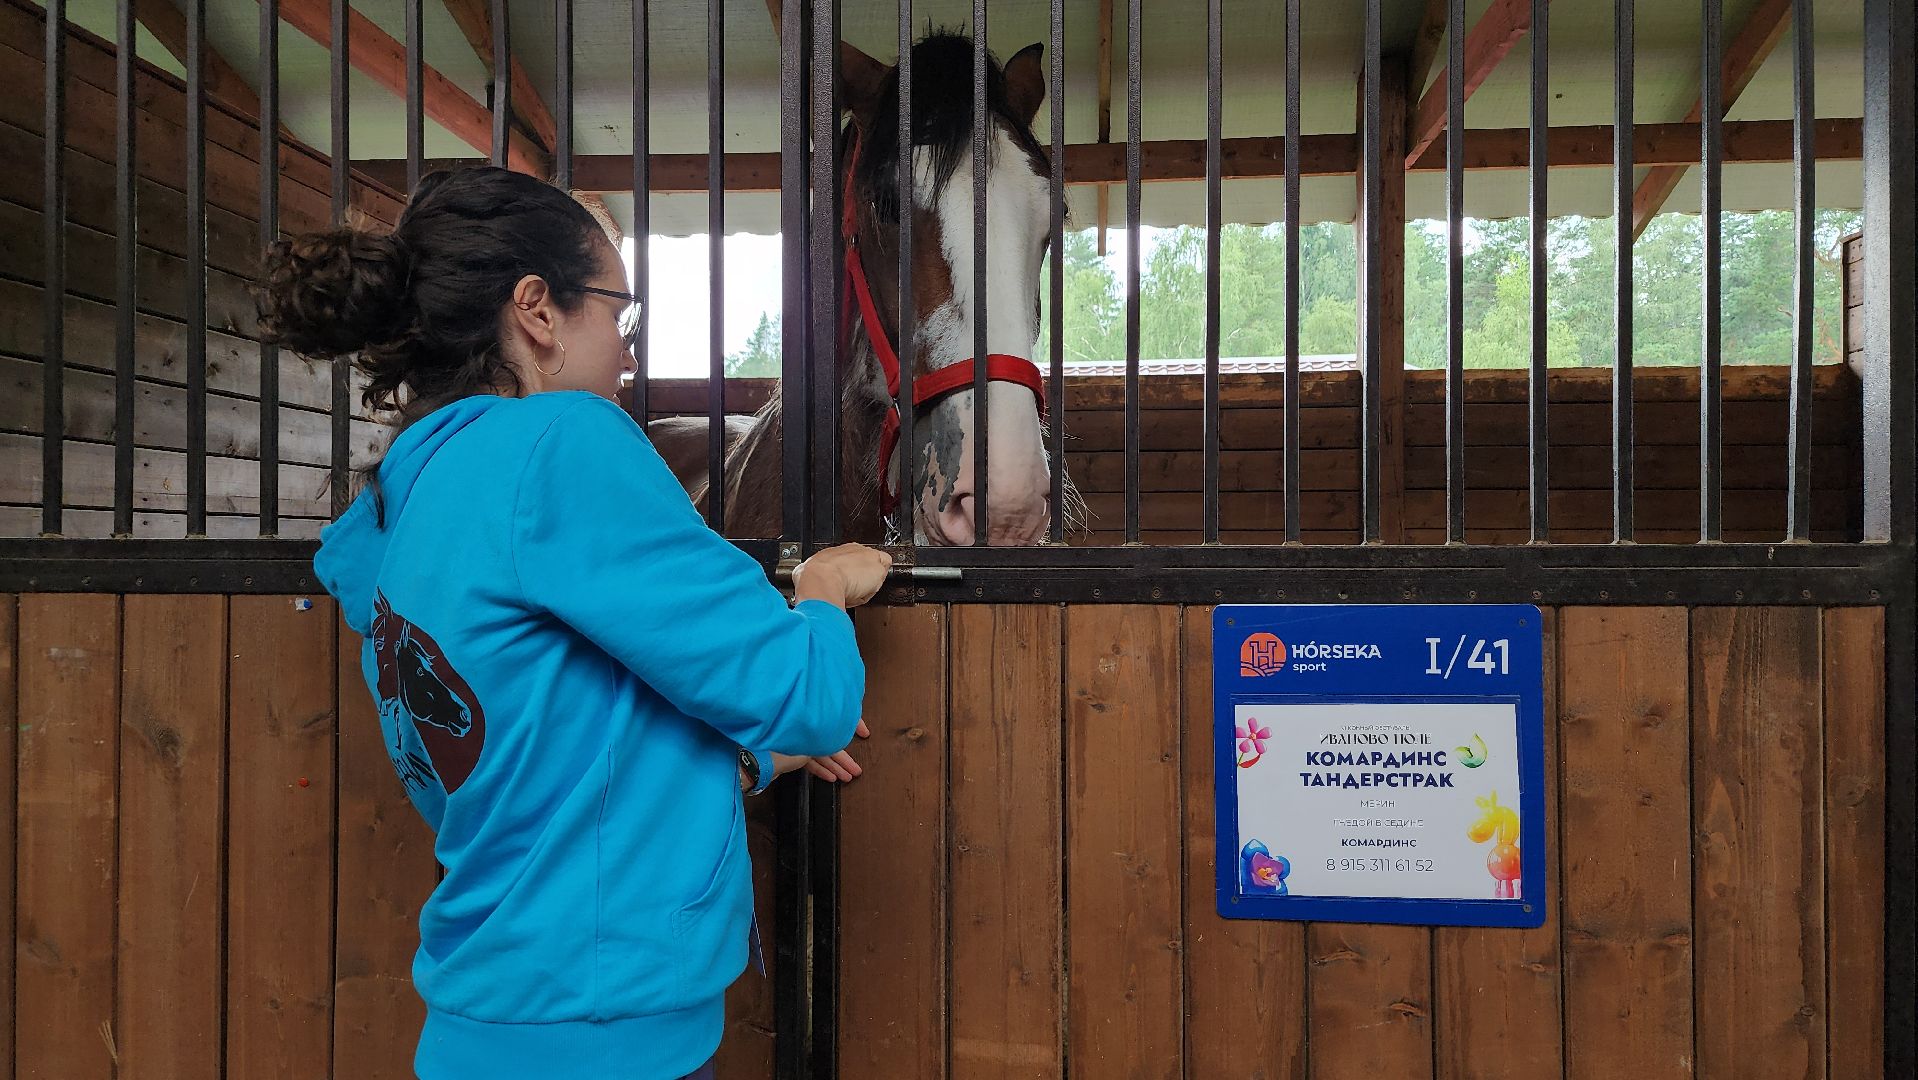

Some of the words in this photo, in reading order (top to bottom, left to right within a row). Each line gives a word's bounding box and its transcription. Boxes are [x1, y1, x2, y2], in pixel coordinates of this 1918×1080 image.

[1291, 640, 1382, 659] HÓRSEKA
[1292, 661, 1327, 674] sport
[1306, 750, 1447, 769] КОМАРДИНС
[1299, 772, 1455, 790] ТАНДЕРСТРАК
[1360, 799, 1395, 808] МЕРИН
[1341, 838, 1418, 849] КОМАРДИНС
[1326, 858, 1336, 871] 8
[1340, 858, 1366, 871] 915
[1369, 858, 1390, 872] 311
[1395, 859, 1410, 872] 61
[1415, 859, 1434, 872] 52
